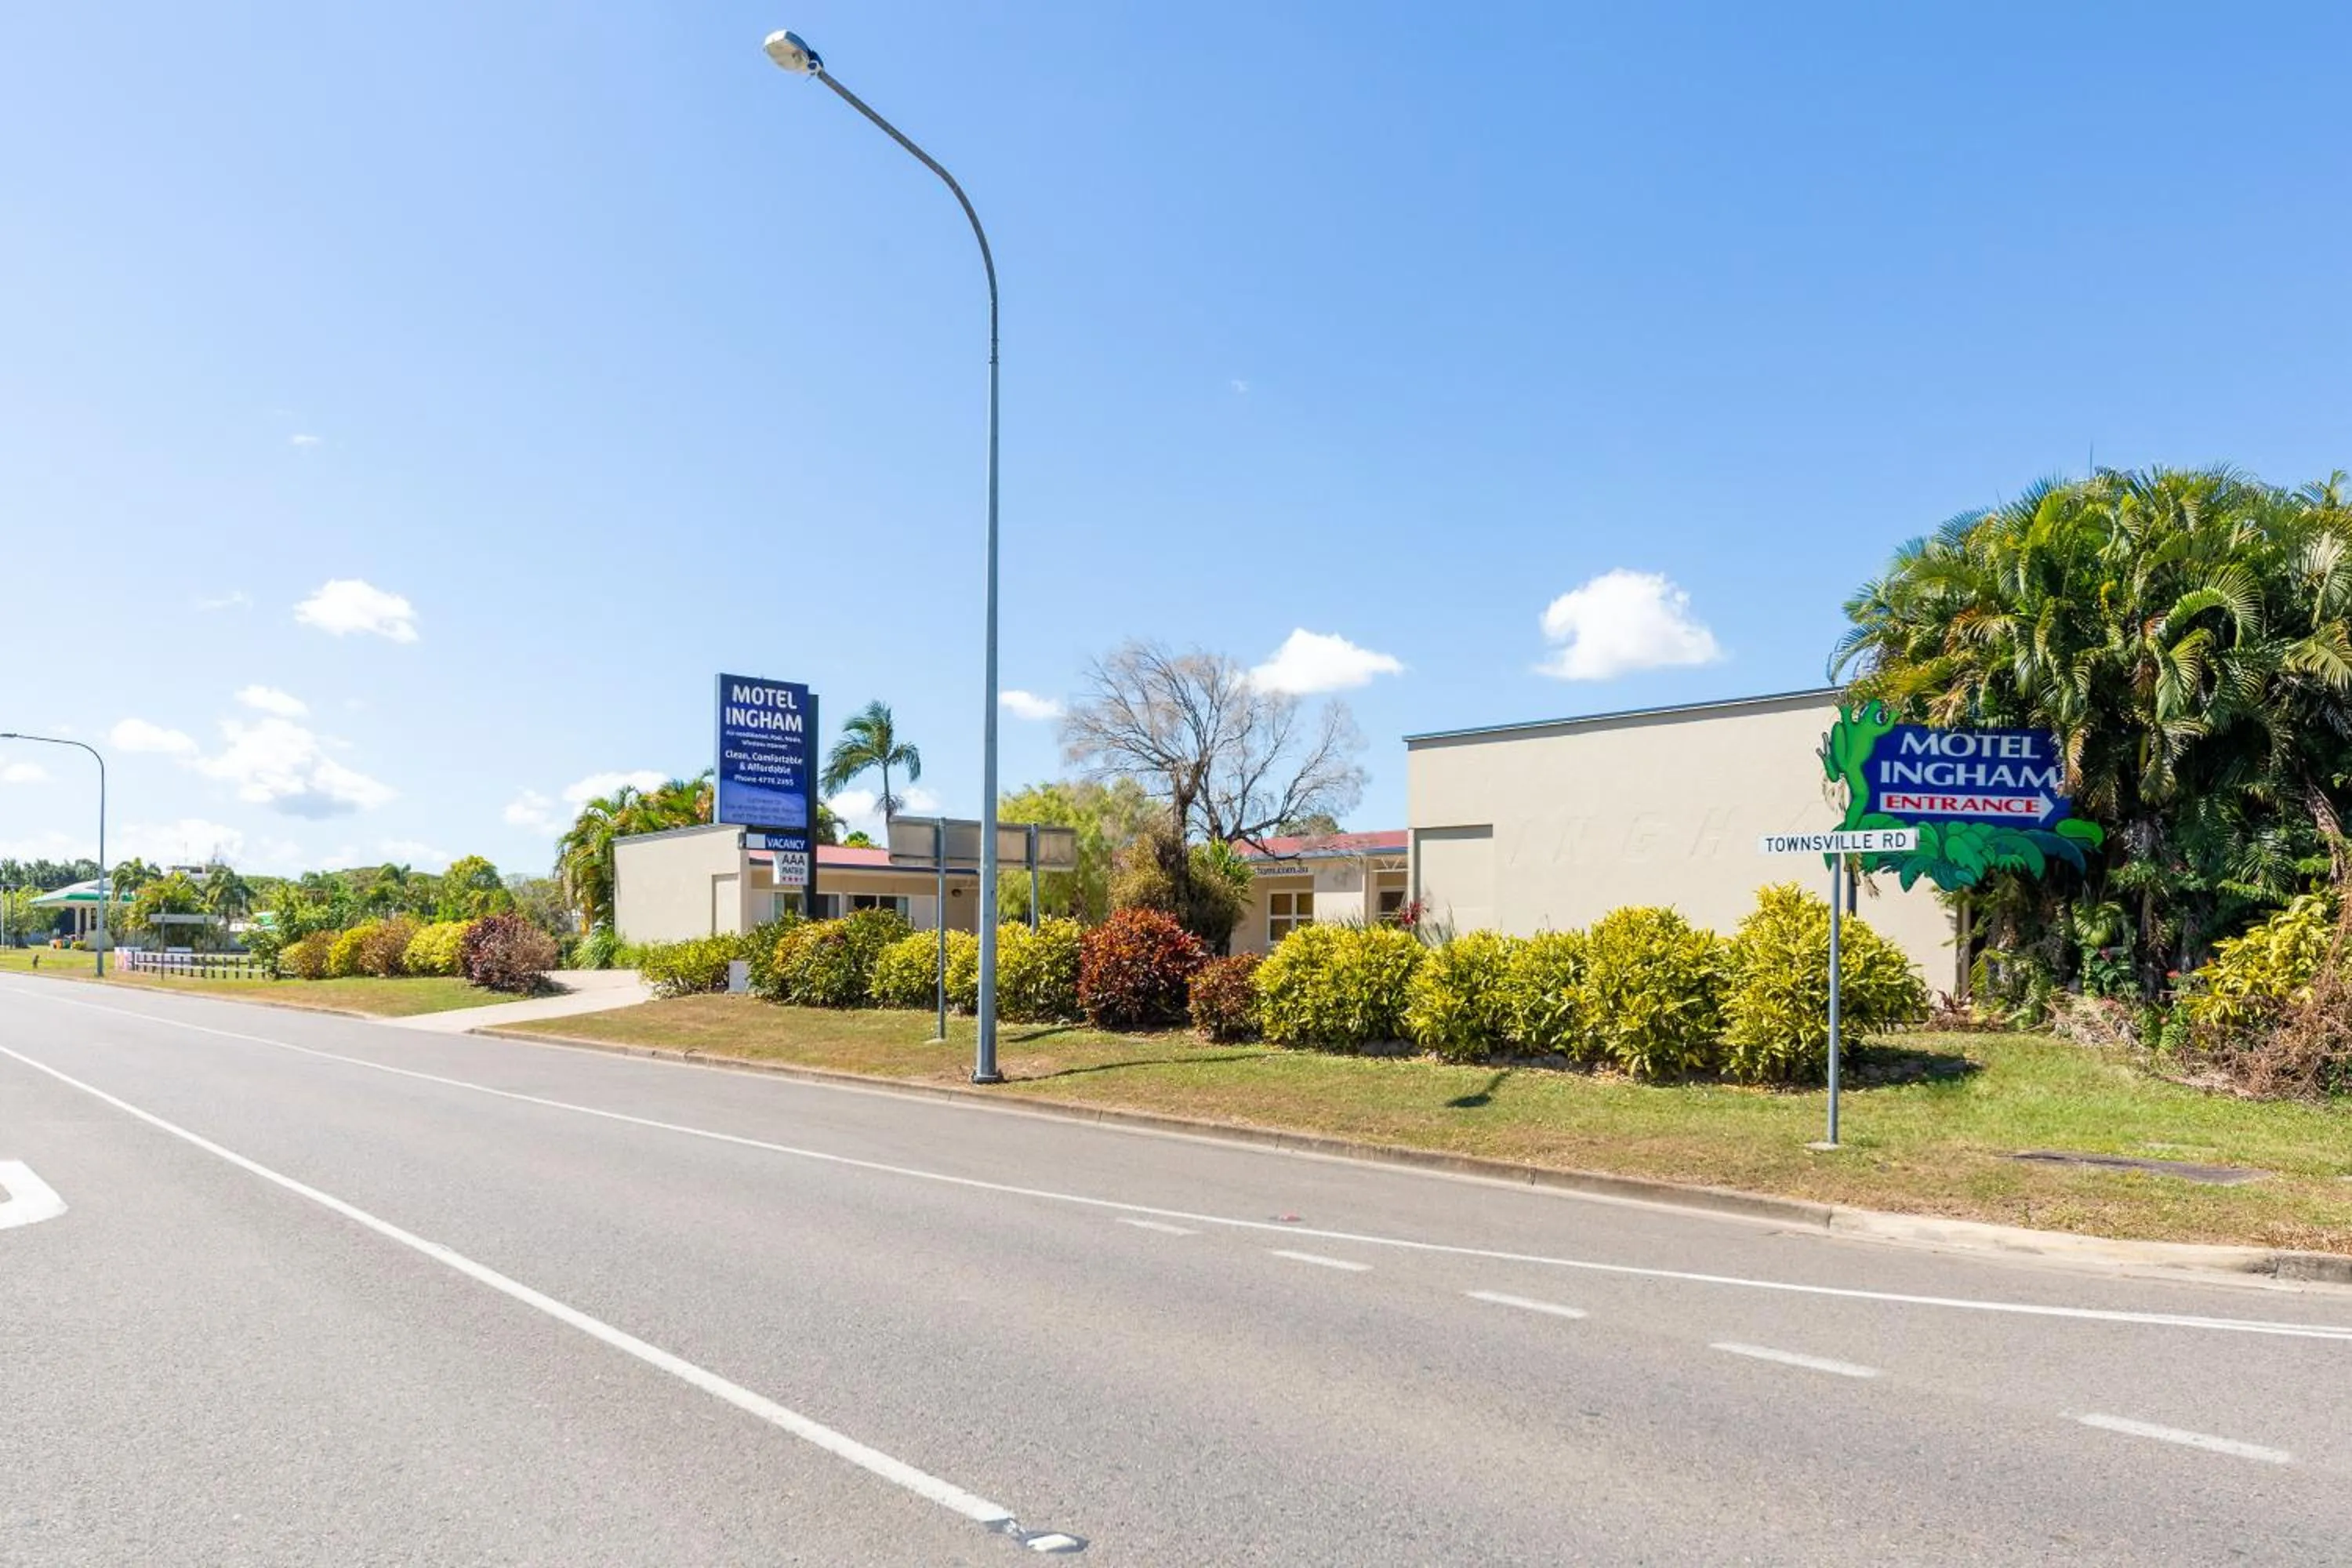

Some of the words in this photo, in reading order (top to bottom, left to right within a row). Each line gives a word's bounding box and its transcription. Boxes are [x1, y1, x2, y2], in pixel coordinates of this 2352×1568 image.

[731, 684, 797, 710] MOTEL
[725, 706, 803, 733] INGHAM
[1900, 731, 2042, 760] MOTEL
[724, 749, 751, 760] Clean,
[752, 752, 804, 766] Comfortable
[739, 761, 746, 771] &
[747, 762, 791, 775] Affordable
[1880, 760, 2060, 789] INGHAM
[1886, 794, 2040, 813] ENTRANCE
[766, 837, 806, 850] VACANCY
[1766, 833, 1873, 852] TOWNSVILLE
[1883, 832, 1907, 848] RD
[782, 854, 805, 866] AAA
